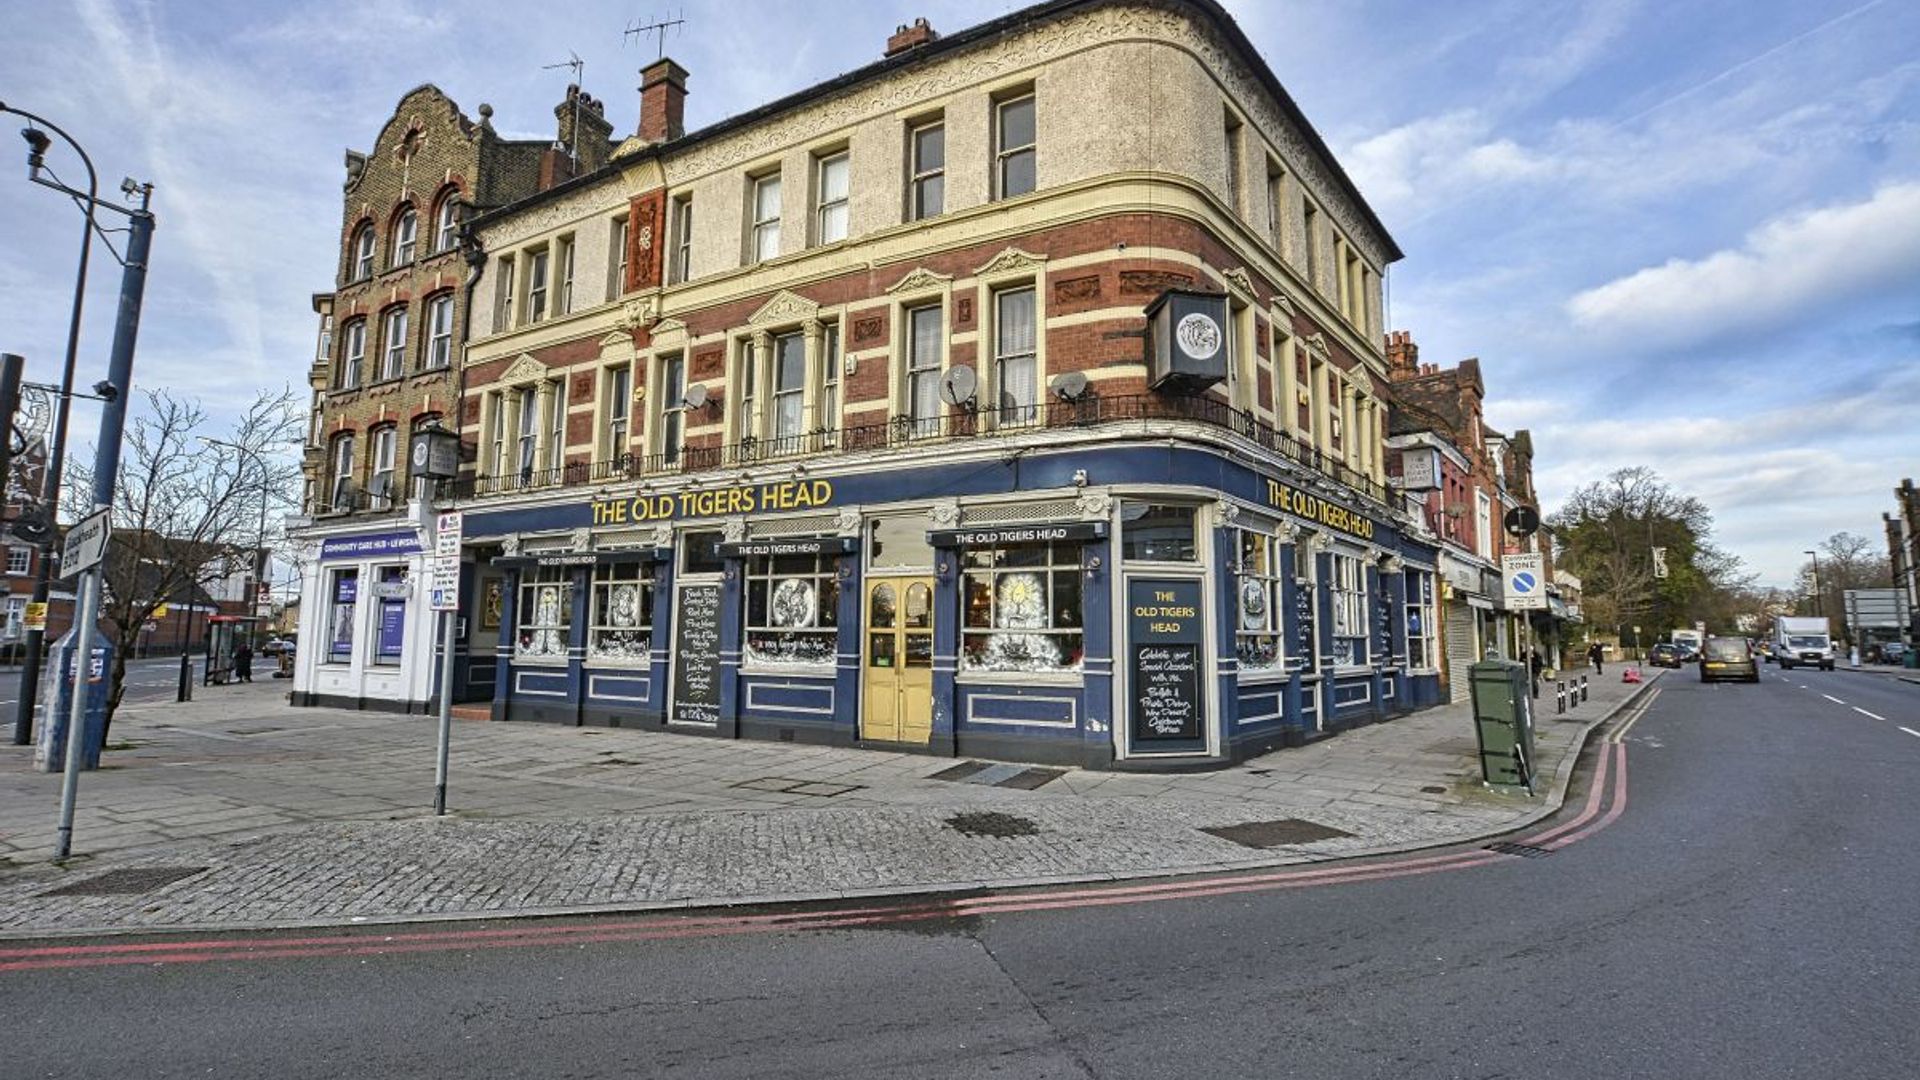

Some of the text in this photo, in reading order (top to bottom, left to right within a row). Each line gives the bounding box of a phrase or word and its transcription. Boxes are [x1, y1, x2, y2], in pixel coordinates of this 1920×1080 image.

[591, 480, 832, 524] THE OLD TIGERS HEAD
[1267, 480, 1372, 538] THE OLD TIGERS HEAD
[955, 528, 1067, 544] THE OLD TIGERS HEAD
[738, 543, 820, 555] THE OLD TIGERS HEAD
[1509, 561, 1536, 569] ZONE
[1155, 591, 1175, 601] THE
[1135, 607, 1195, 617] OLD TIGERS
[1150, 623, 1180, 633] HEAD
